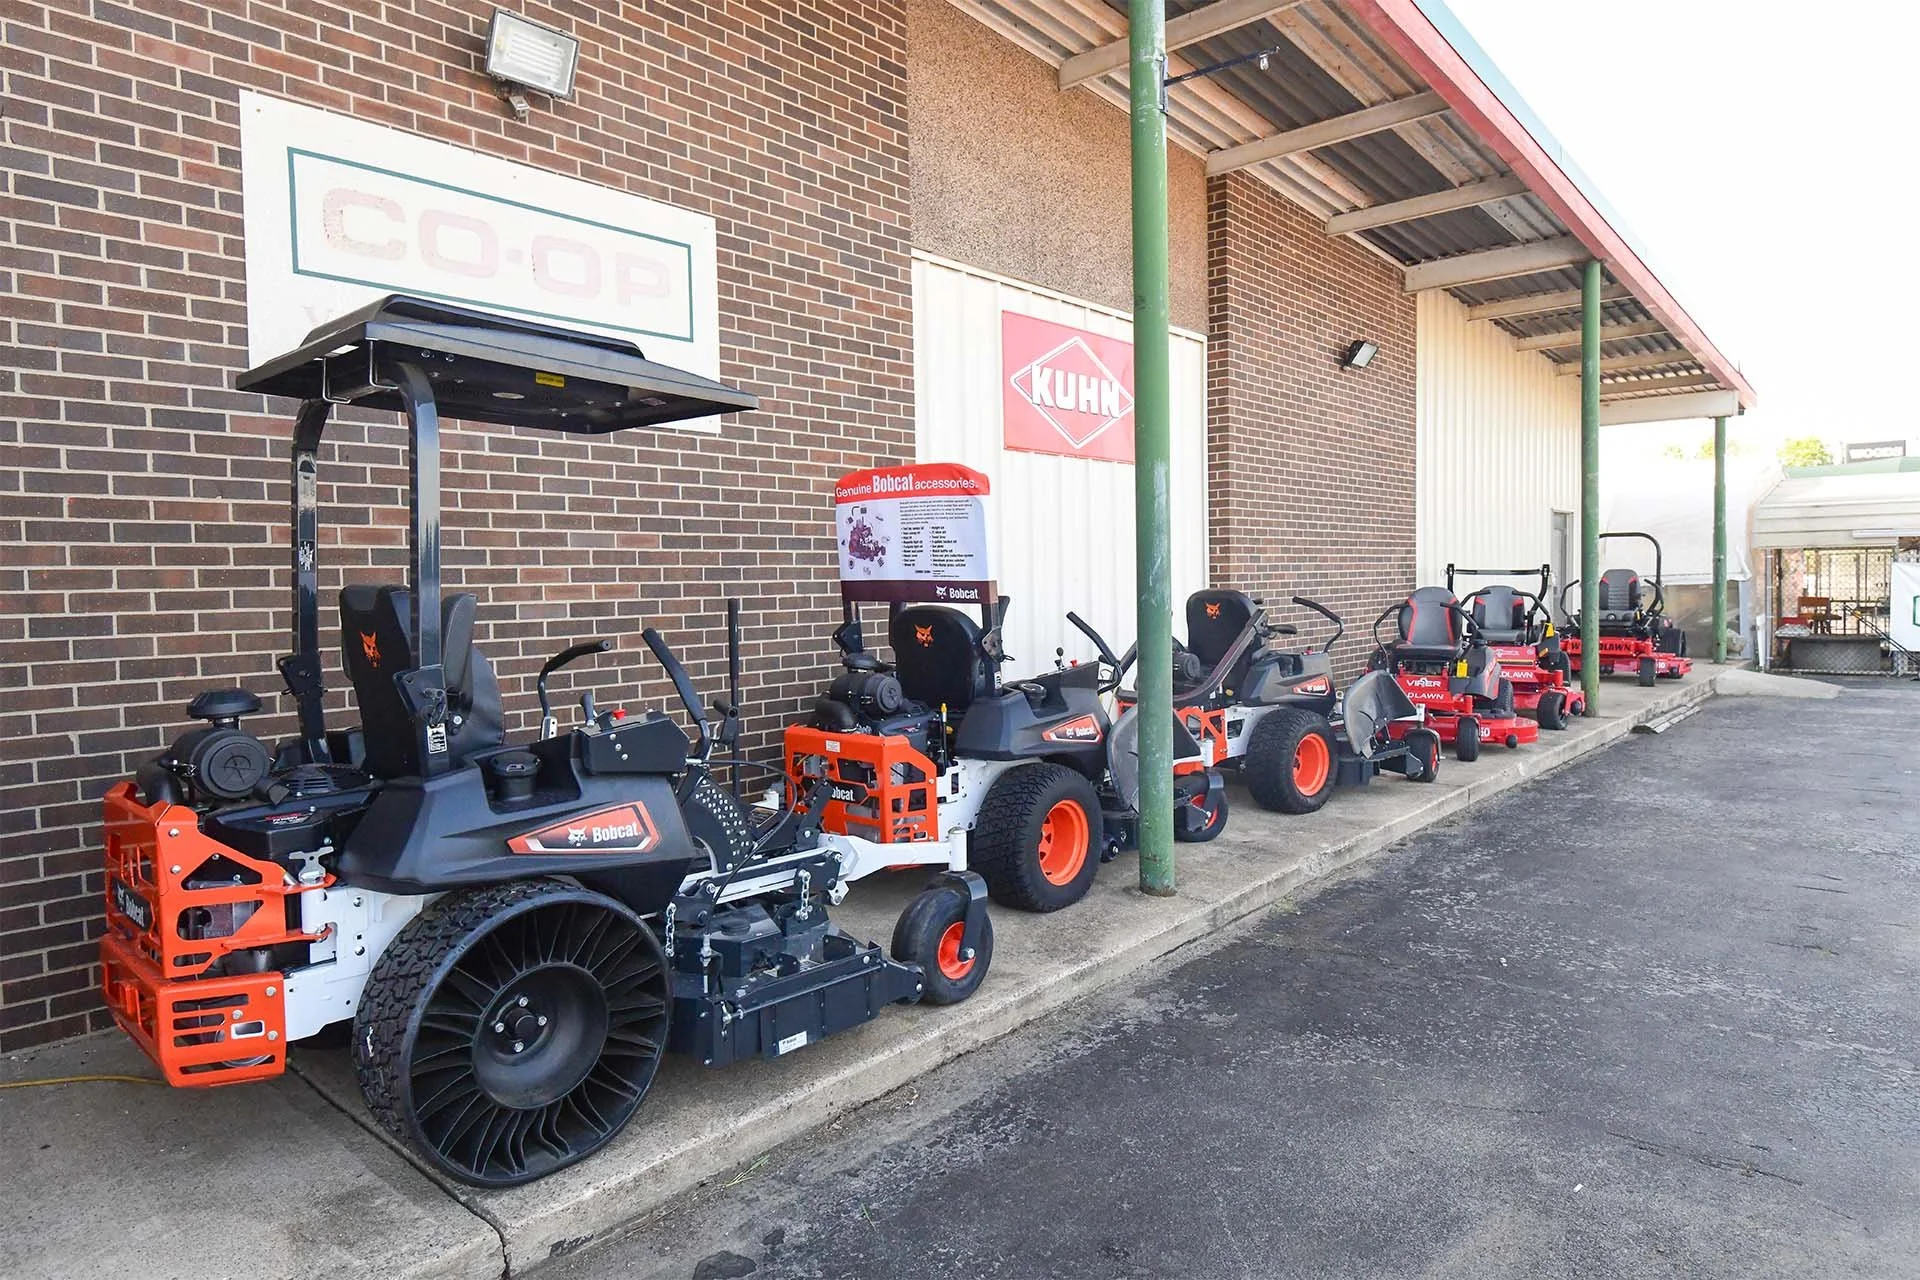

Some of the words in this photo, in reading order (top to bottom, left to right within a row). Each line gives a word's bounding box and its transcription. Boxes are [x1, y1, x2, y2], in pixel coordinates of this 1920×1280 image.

[1030, 364, 1121, 419] KUHN
[835, 485, 871, 498] Genuine
[872, 474, 914, 493] Bobcat
[949, 587, 979, 600] Bobcat
[831, 786, 854, 802] obcat
[591, 821, 641, 843] Bobcat
